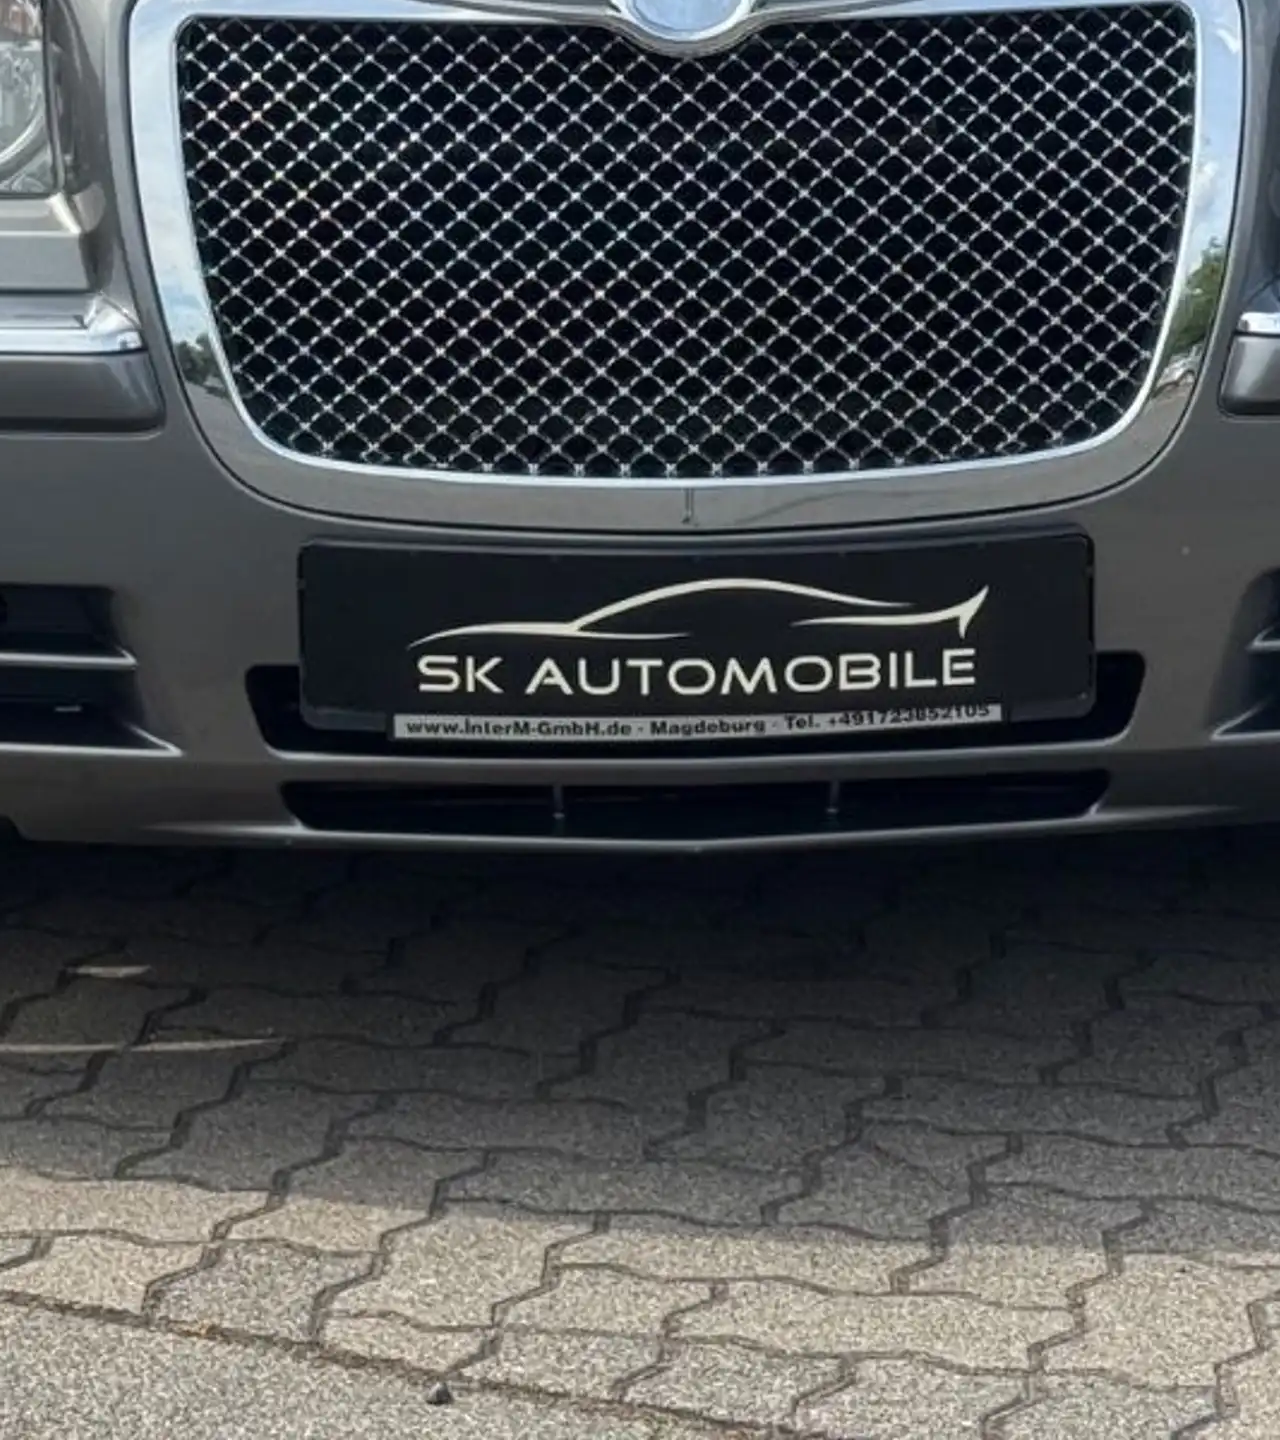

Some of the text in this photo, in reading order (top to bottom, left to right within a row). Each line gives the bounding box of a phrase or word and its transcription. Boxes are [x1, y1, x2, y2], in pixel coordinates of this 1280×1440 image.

[418, 648, 977, 696] SK AUTOMOBILE
[784, 712, 820, 731] Tel.
